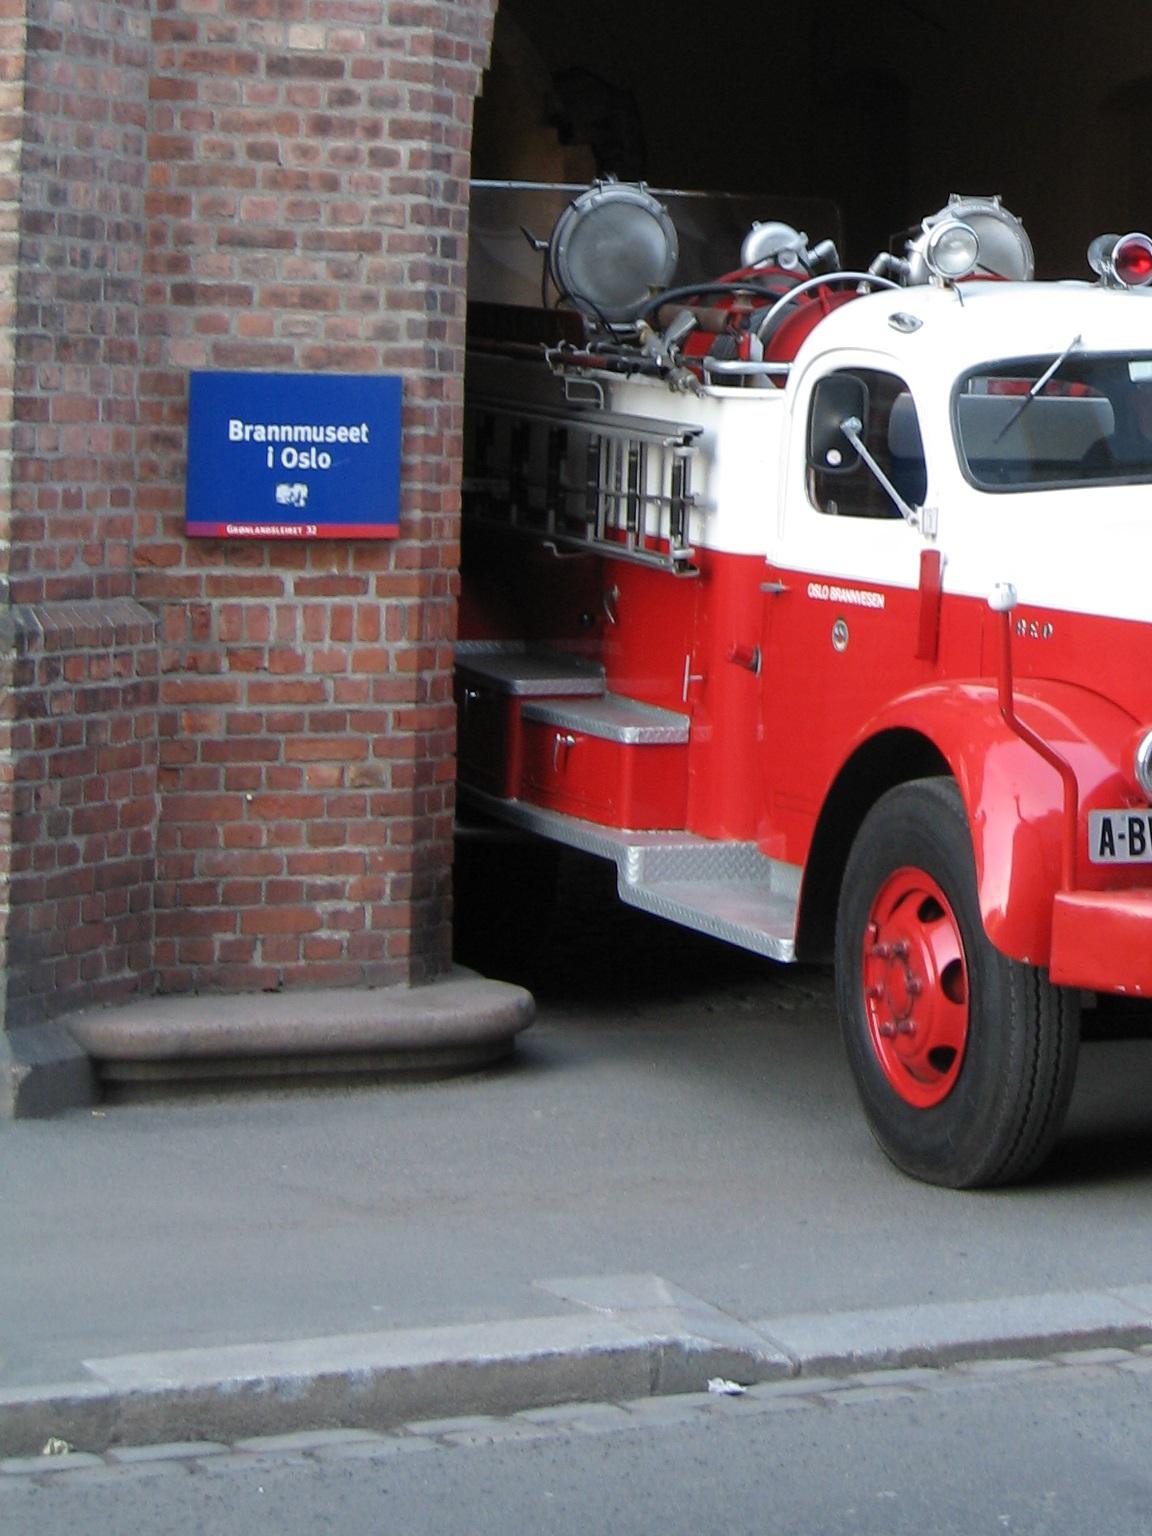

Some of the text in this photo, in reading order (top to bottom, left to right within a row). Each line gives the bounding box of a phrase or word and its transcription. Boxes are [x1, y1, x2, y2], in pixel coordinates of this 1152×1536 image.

[228, 419, 369, 443] Brannmuseet
[267, 445, 332, 469] i Oslo
[807, 582, 829, 600] OSLO
